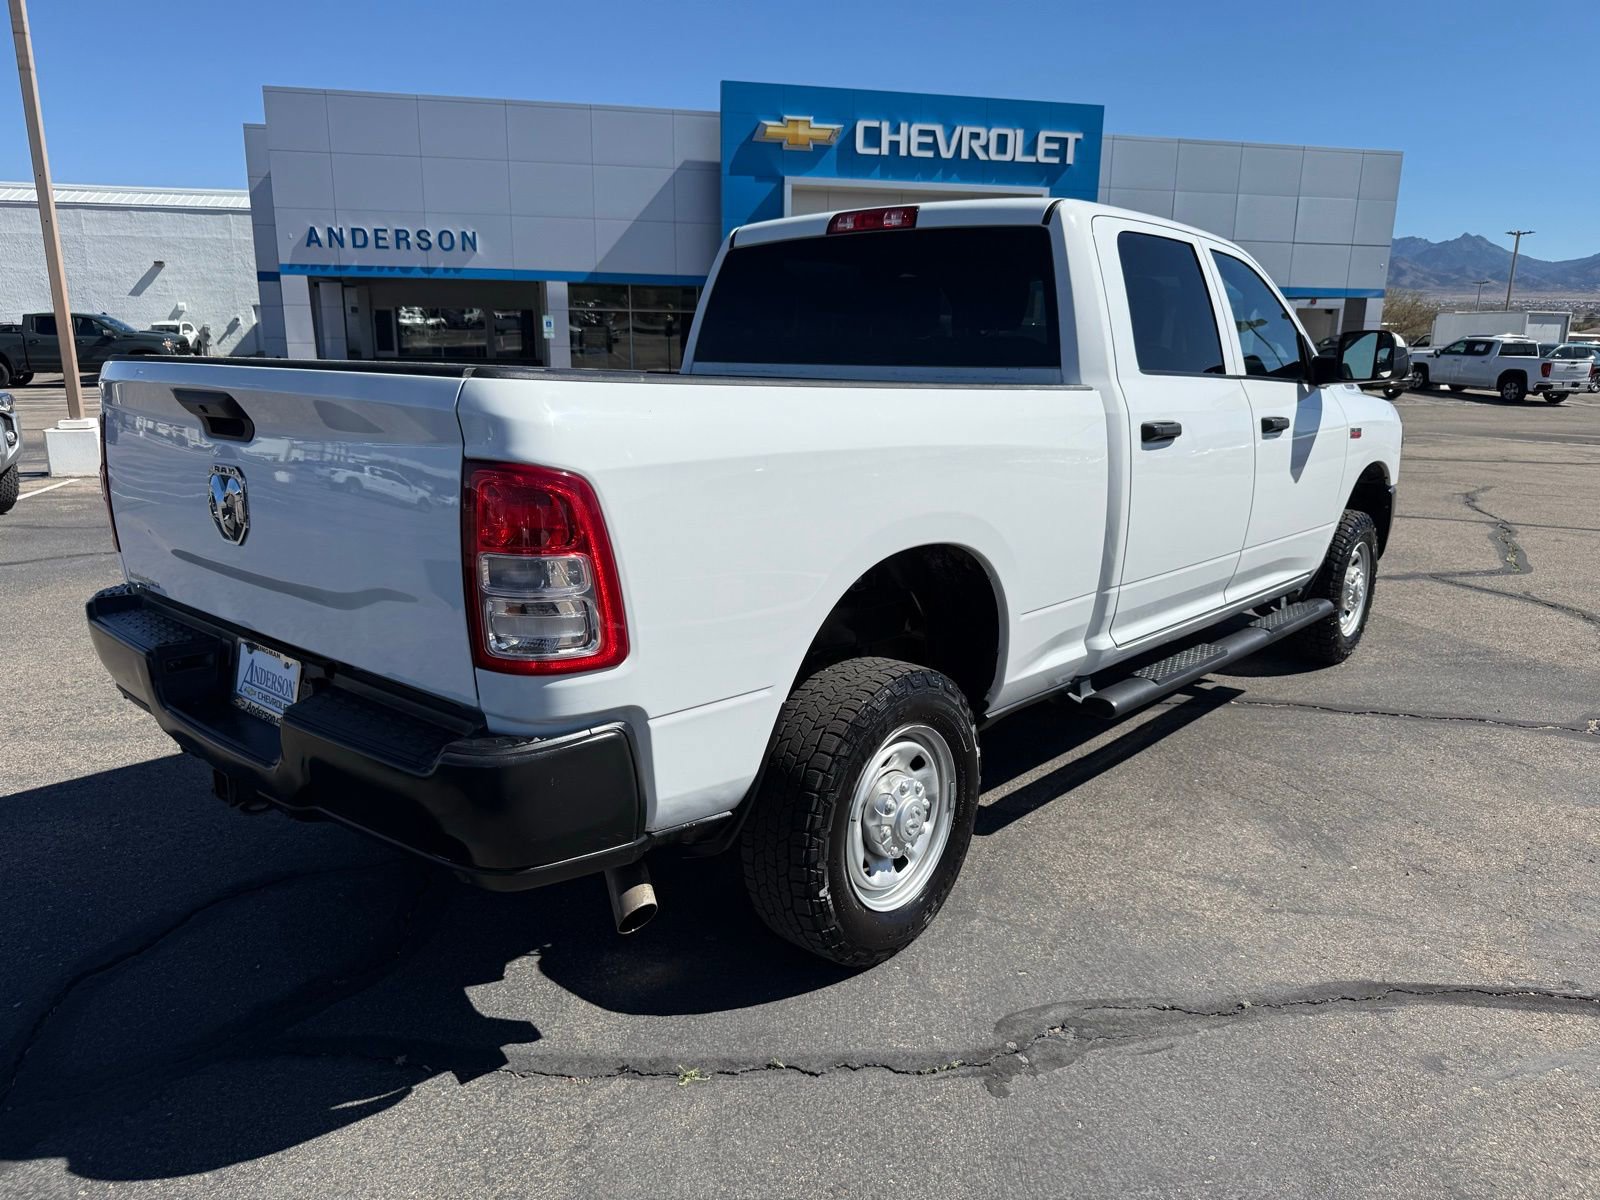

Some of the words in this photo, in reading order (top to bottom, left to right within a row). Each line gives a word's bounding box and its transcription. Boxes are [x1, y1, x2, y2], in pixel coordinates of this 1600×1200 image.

[855, 119, 1083, 165] CHEVROLET
[305, 226, 477, 252] ANDERSON
[214, 465, 236, 475] RAM
